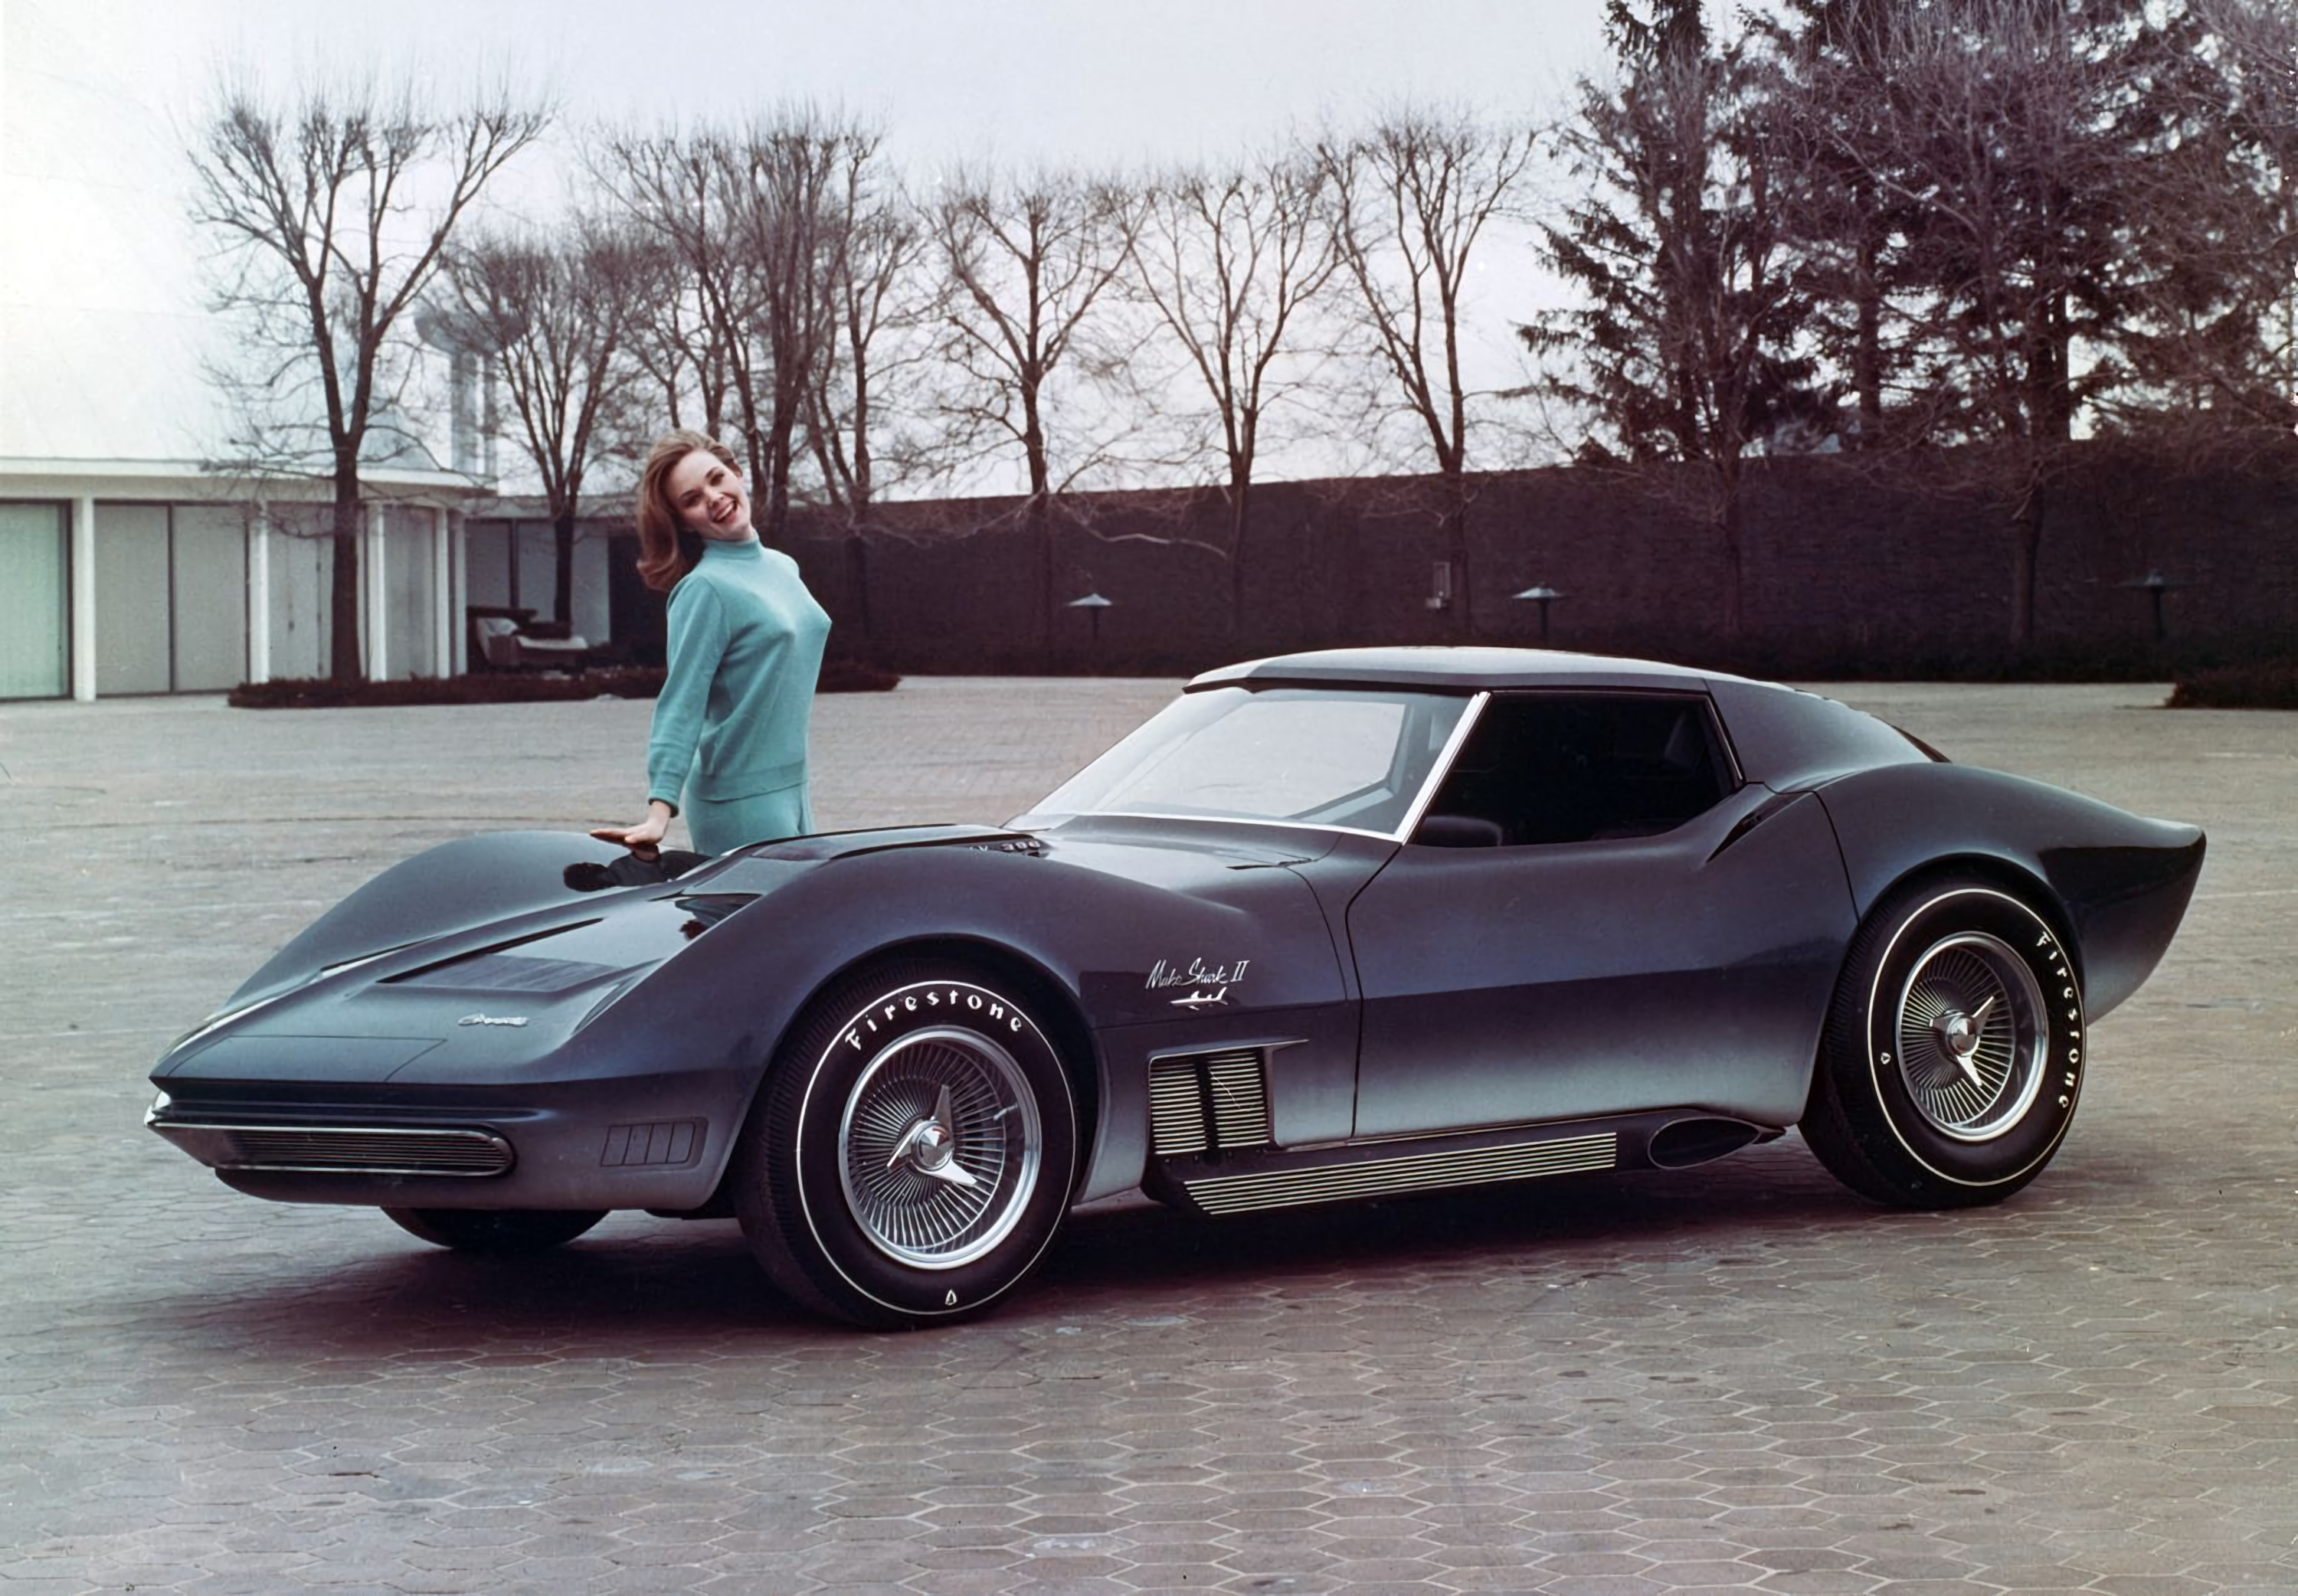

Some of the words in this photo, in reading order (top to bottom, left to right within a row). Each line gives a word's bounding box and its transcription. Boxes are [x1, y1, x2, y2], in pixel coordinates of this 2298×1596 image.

[1145, 959, 1183, 989] Mako
[1182, 957, 1229, 986] Shark
[1229, 960, 1251, 983] II
[845, 989, 1022, 1051] Firestone
[2036, 930, 2080, 1108] Firestone
